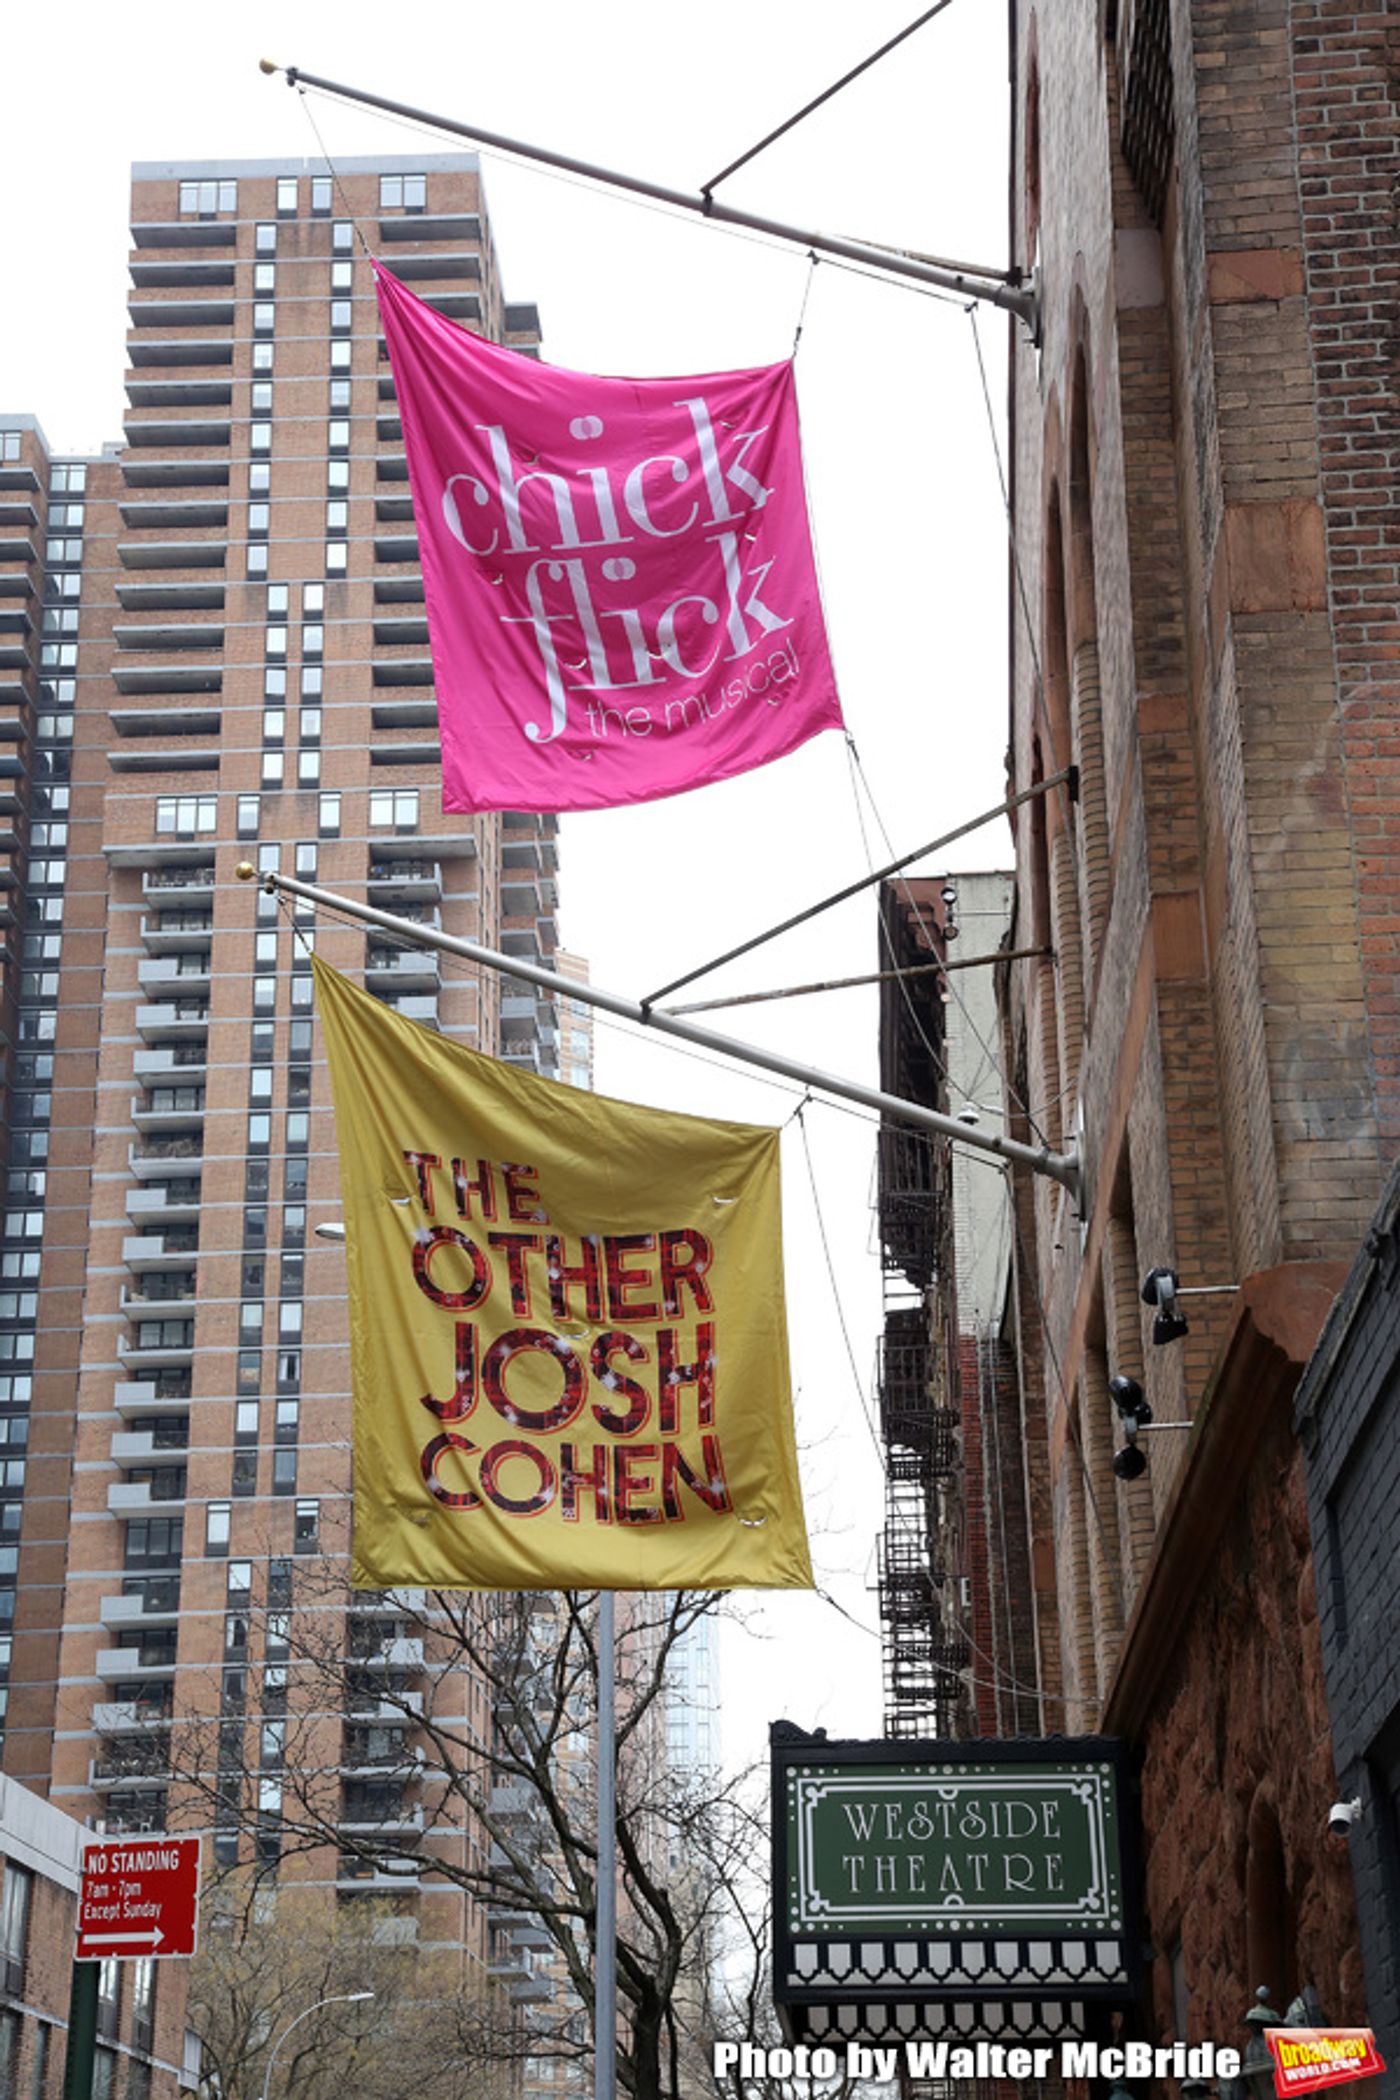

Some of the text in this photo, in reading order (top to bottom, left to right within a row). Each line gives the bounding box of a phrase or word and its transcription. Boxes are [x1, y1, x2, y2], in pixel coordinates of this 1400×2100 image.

[441, 397, 775, 556] chick
[500, 532, 795, 744] flick
[585, 637, 800, 738] the musical
[403, 1150, 550, 1225] THE
[412, 1226, 716, 1324] OTHER
[420, 1321, 717, 1439] JOSH
[420, 1432, 734, 1527] COHEN
[88, 1849, 179, 1874] NO STANDING
[844, 1800, 1062, 1841] WESTSIDE
[84, 1900, 162, 1922] Except Sunday
[87, 1881, 109, 1898] 7am
[119, 1880, 141, 1900] 7pm
[842, 1853, 1065, 1892] THEATRE
